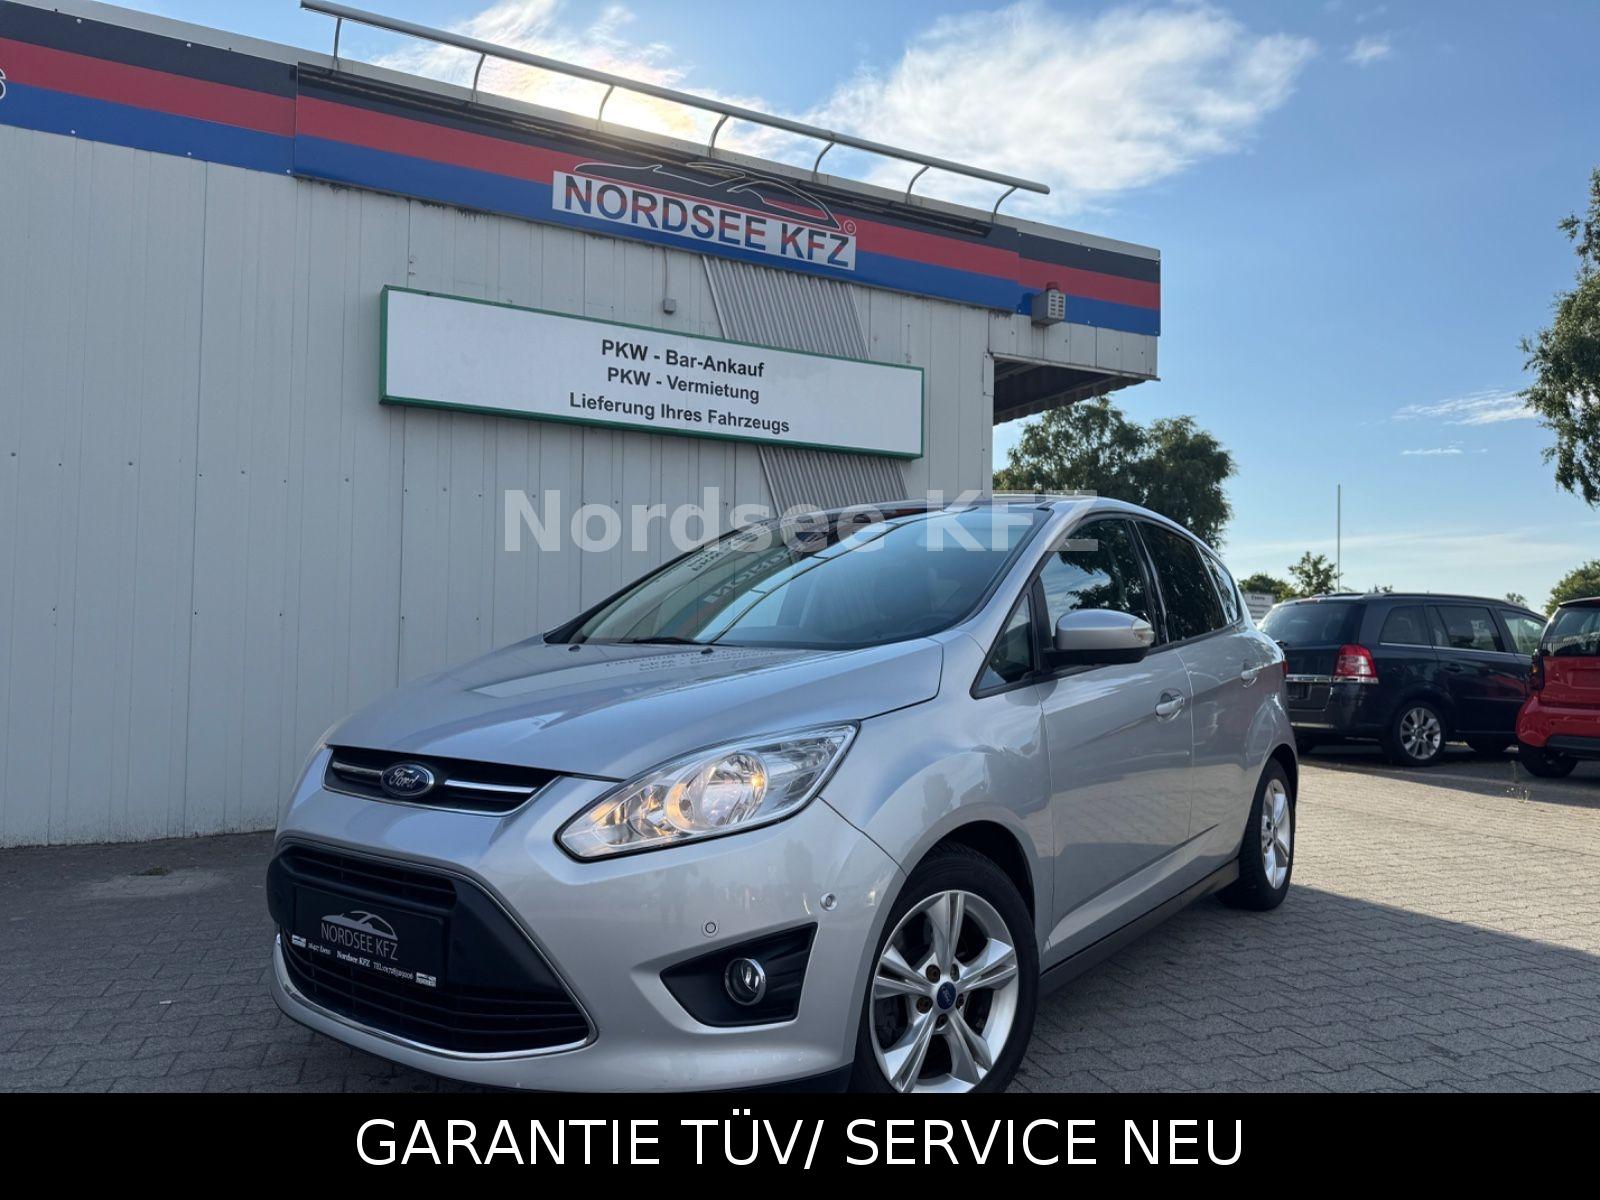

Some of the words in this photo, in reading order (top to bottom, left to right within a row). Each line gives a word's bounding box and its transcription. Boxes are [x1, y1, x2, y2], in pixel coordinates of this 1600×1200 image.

[564, 174, 768, 251] NORDSEE
[780, 222, 849, 268] KFZ
[601, 338, 648, 361] PKW
[665, 349, 765, 377] Bar-Ankauf
[607, 366, 651, 387] PKW
[666, 374, 760, 404] Vermietung
[569, 392, 655, 420] Lieferung
[660, 403, 702, 423] Ihres
[707, 409, 790, 435] Fahrzeugs
[388, 767, 420, 790] Ford
[320, 922, 374, 953] NORDSEE
[375, 940, 398, 961] KFZ
